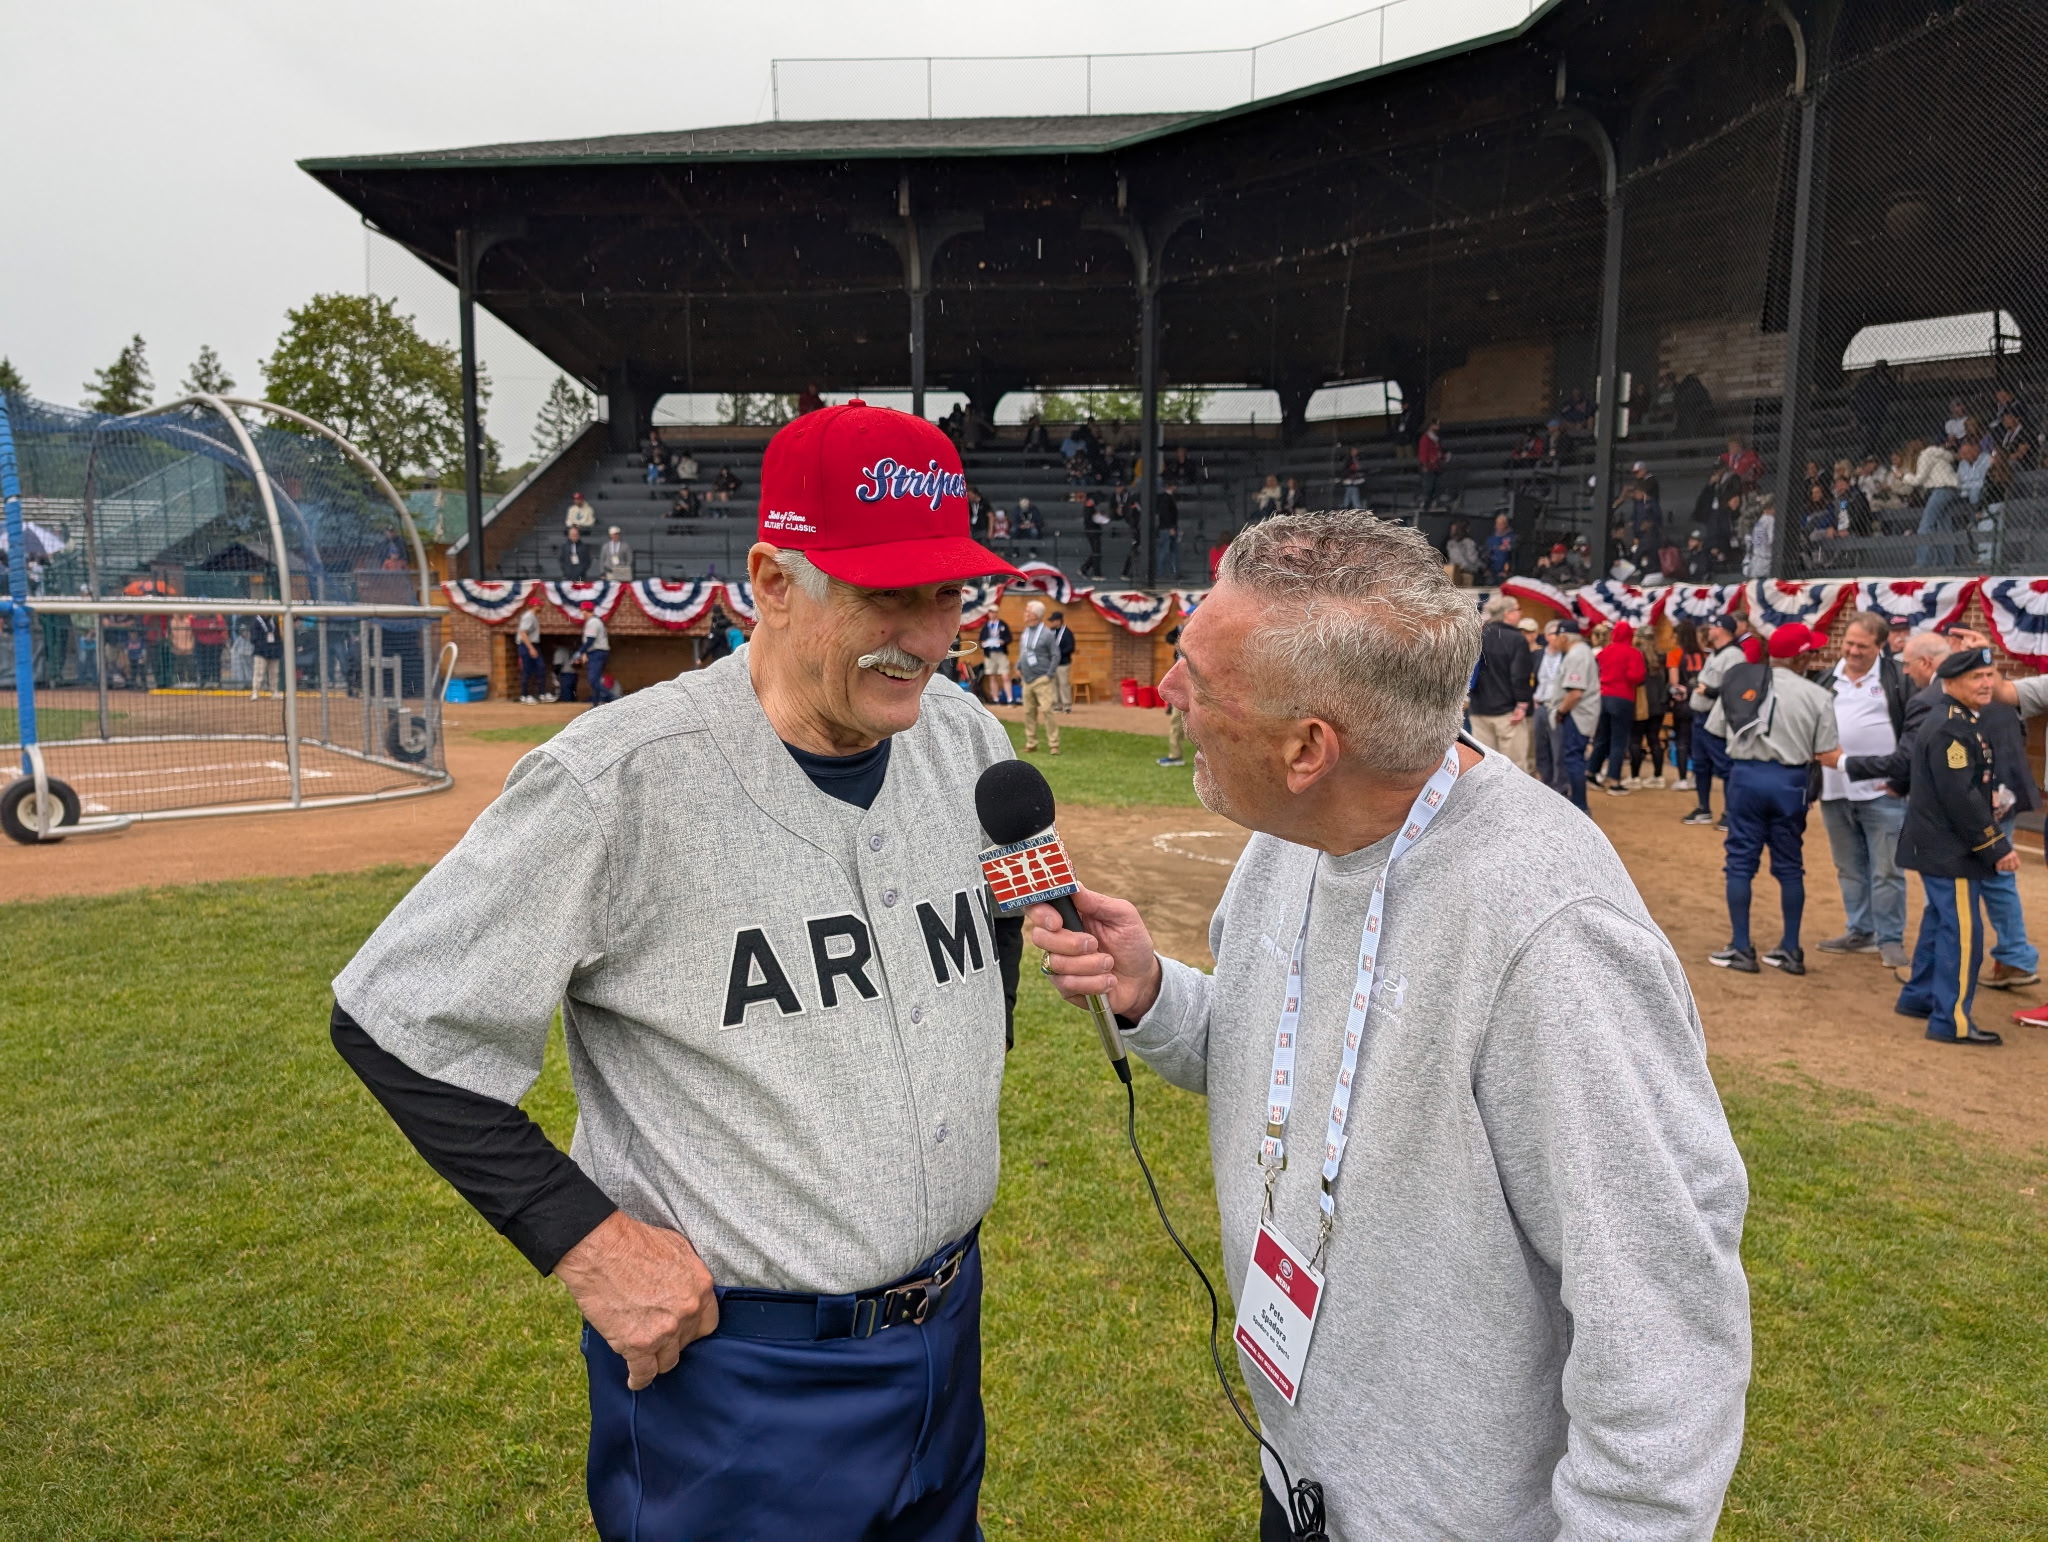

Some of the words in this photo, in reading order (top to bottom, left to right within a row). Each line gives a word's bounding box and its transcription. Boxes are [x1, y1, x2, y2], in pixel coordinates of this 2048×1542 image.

[780, 511, 788, 523] of
[787, 511, 806, 522] Fame
[785, 523, 817, 533] CLASSIC
[1012, 841, 1026, 853] ON
[1025, 832, 1056, 849] SPORTS
[1006, 896, 1030, 910] SPORTS
[1029, 891, 1051, 904] MEDIA
[1050, 885, 1071, 898] GROUP
[1275, 1273, 1291, 1294] MEDIA
[1269, 1302, 1284, 1324] Pete
[1261, 1308, 1287, 1342] Spadora
[1252, 1314, 1269, 1337] Spadora
[1275, 1340, 1290, 1360] Sports
